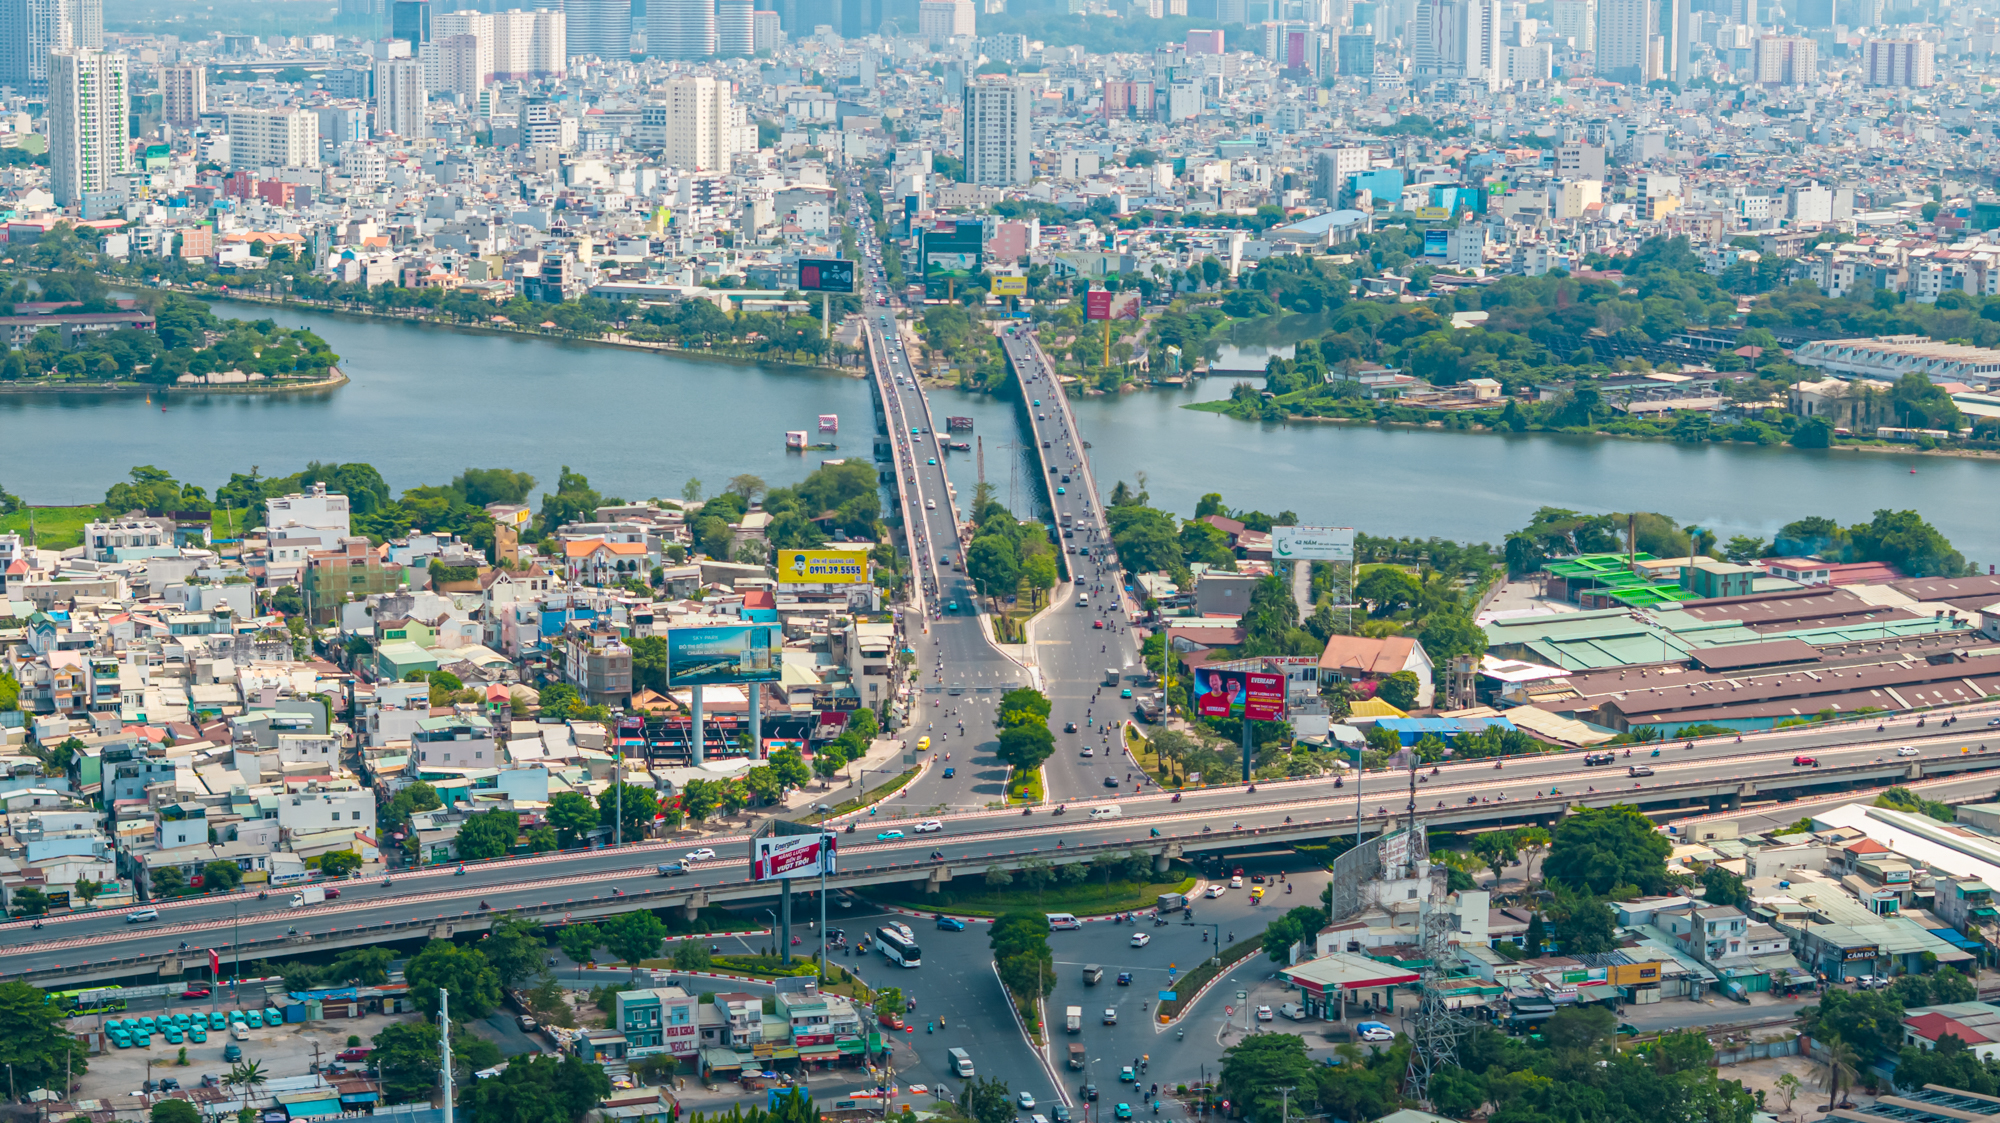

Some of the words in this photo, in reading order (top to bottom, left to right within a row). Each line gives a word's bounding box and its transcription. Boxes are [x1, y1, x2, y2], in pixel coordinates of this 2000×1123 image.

[810, 566, 860, 574] 0911.39.5555
[775, 839, 800, 851] Energizer
[777, 863, 794, 872] VƯỢT
[667, 1027, 678, 1037] NHA
[680, 1026, 695, 1036] KHOA
